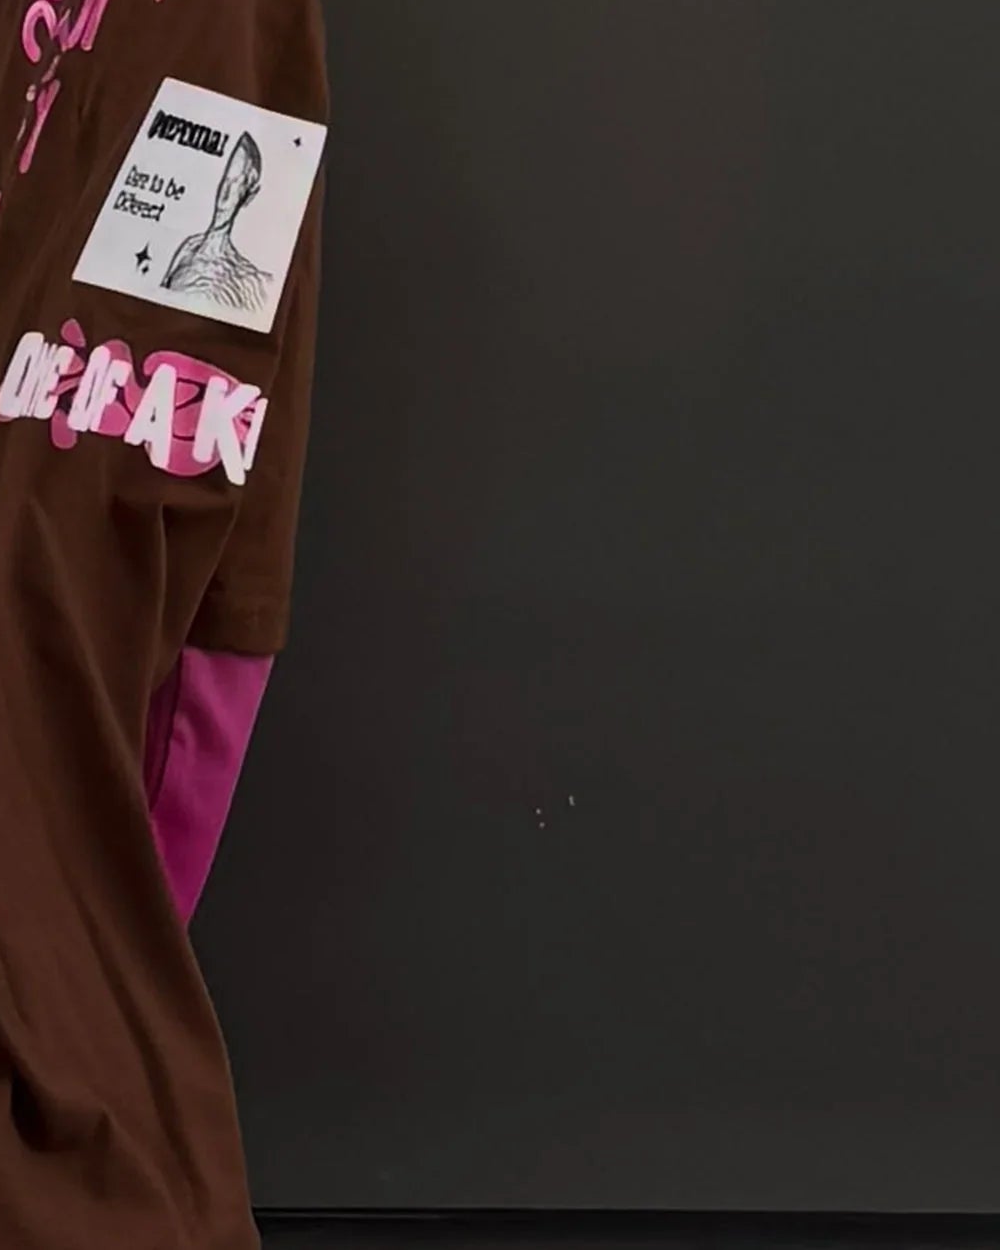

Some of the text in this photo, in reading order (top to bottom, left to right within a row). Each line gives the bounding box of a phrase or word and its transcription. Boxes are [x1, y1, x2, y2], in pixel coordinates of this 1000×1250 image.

[165, 177, 185, 201] be
[67, 345, 133, 432] OF
[123, 363, 177, 470] A
